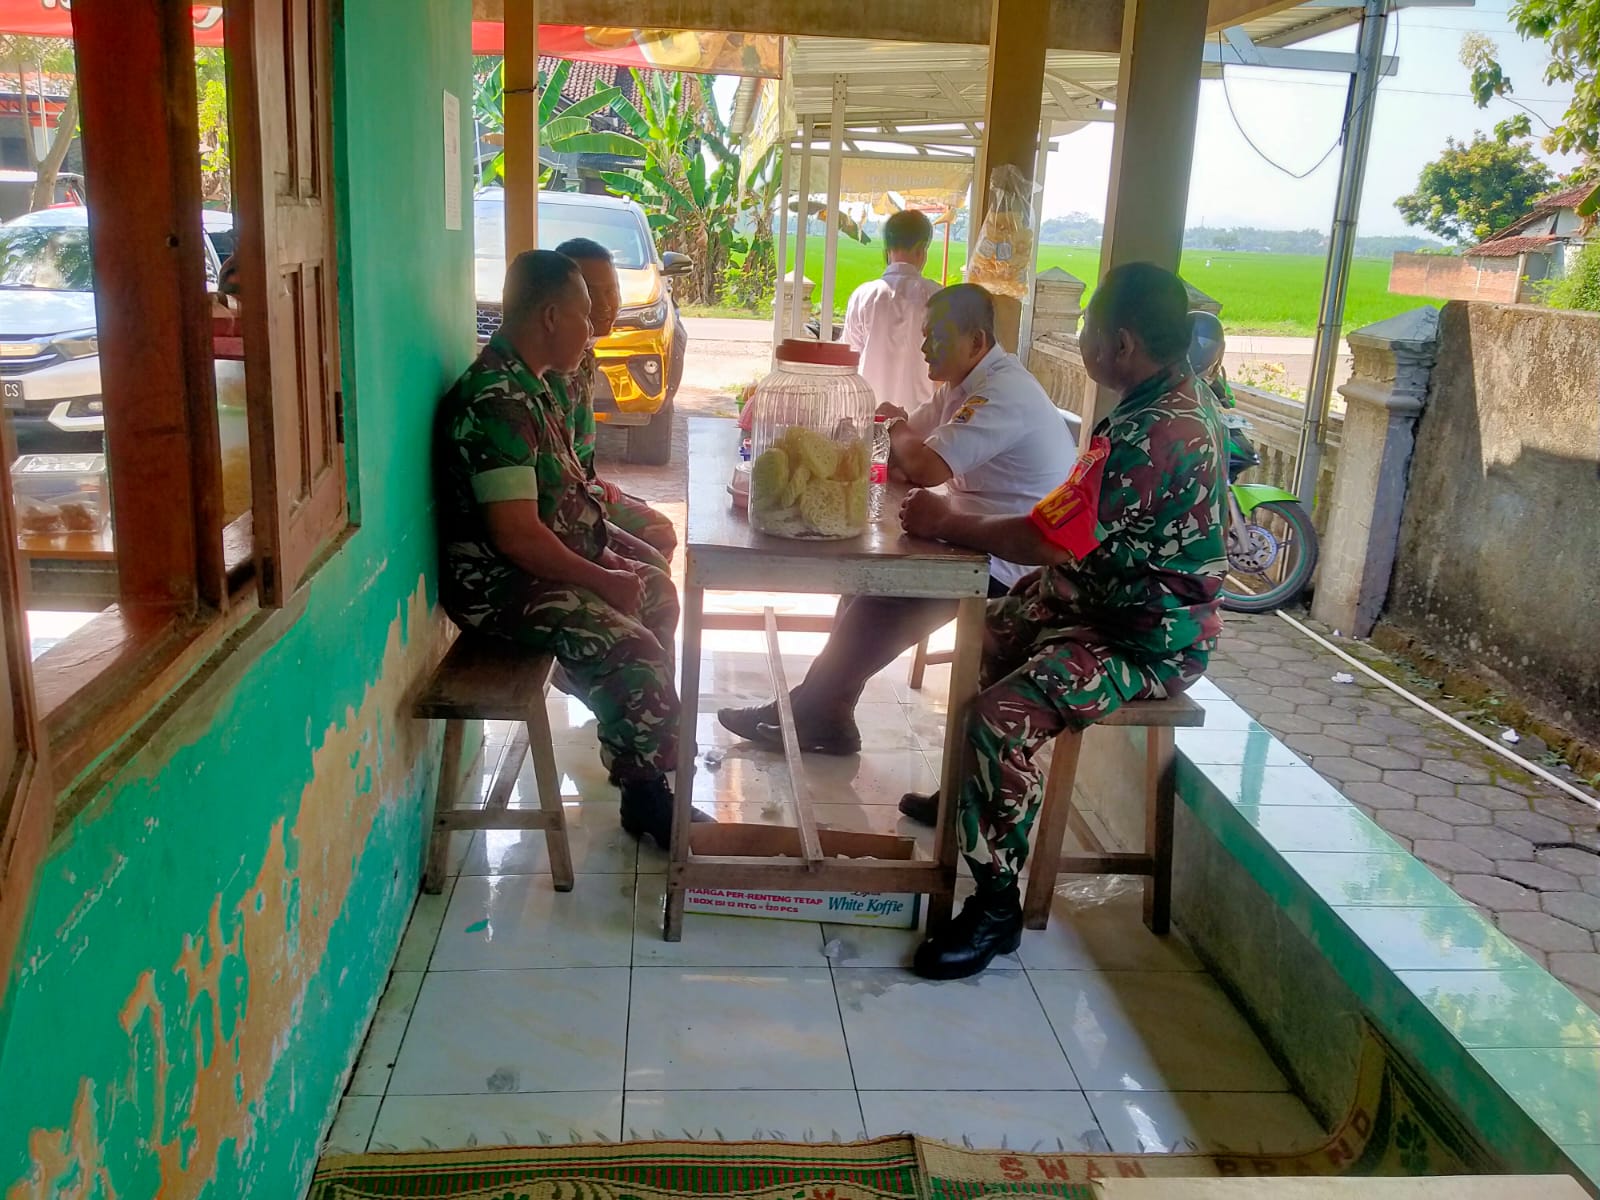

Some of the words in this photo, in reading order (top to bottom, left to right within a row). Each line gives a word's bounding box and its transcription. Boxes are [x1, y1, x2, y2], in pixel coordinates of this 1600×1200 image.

[4, 383, 19, 397] CS
[693, 898, 713, 906] BOX
[793, 896, 823, 905] TETAP
[829, 896, 864, 911] White
[866, 898, 904, 916] Koffie
[998, 1156, 1148, 1180] SWAN
